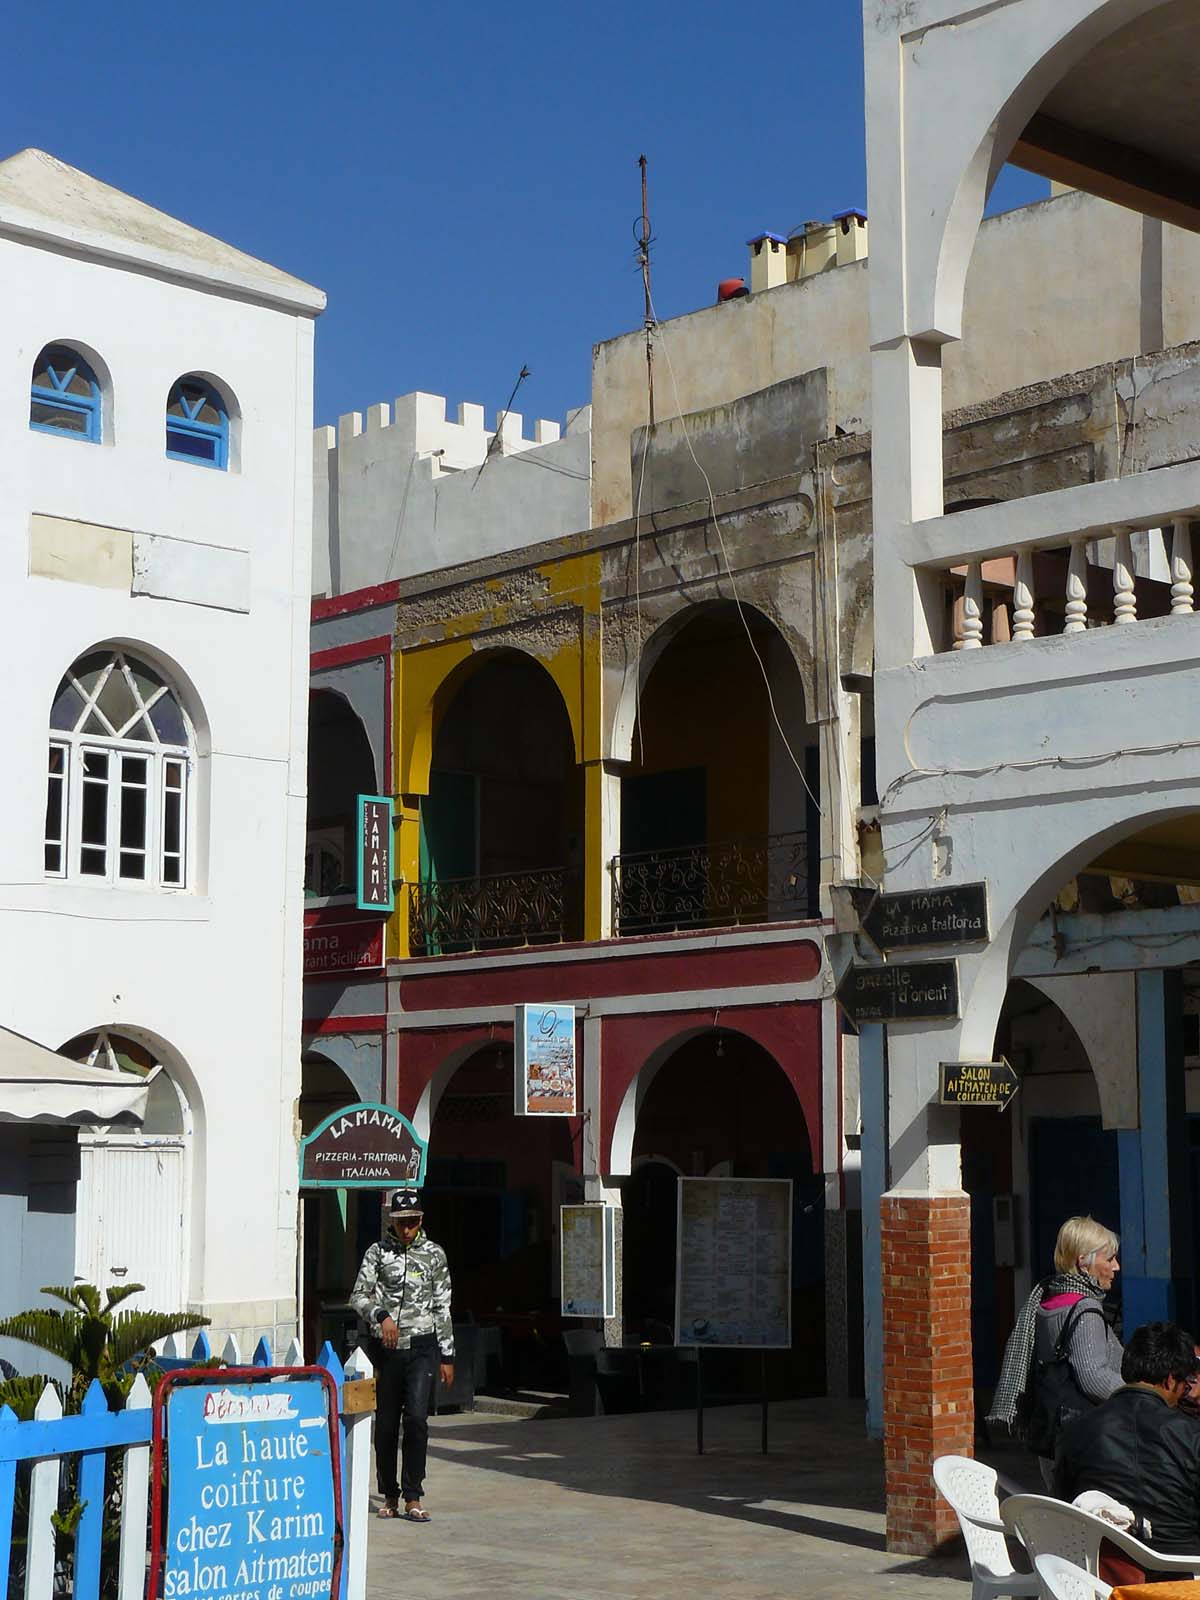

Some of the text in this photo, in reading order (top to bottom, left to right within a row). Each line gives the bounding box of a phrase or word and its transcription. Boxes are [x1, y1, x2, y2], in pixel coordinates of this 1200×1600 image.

[931, 913, 982, 932] trattoria
[960, 1066, 991, 1081] SALON
[329, 1109, 404, 1140] LA MAMA
[341, 1166, 391, 1178] ITALIANA
[196, 1430, 308, 1470] La haute
[201, 1469, 305, 1509] coiffure
[177, 1505, 324, 1552] chez Karim
[165, 1549, 332, 1596] salon Aitmaten
[268, 1584, 284, 1600] de
[291, 1578, 332, 1597] coupes
